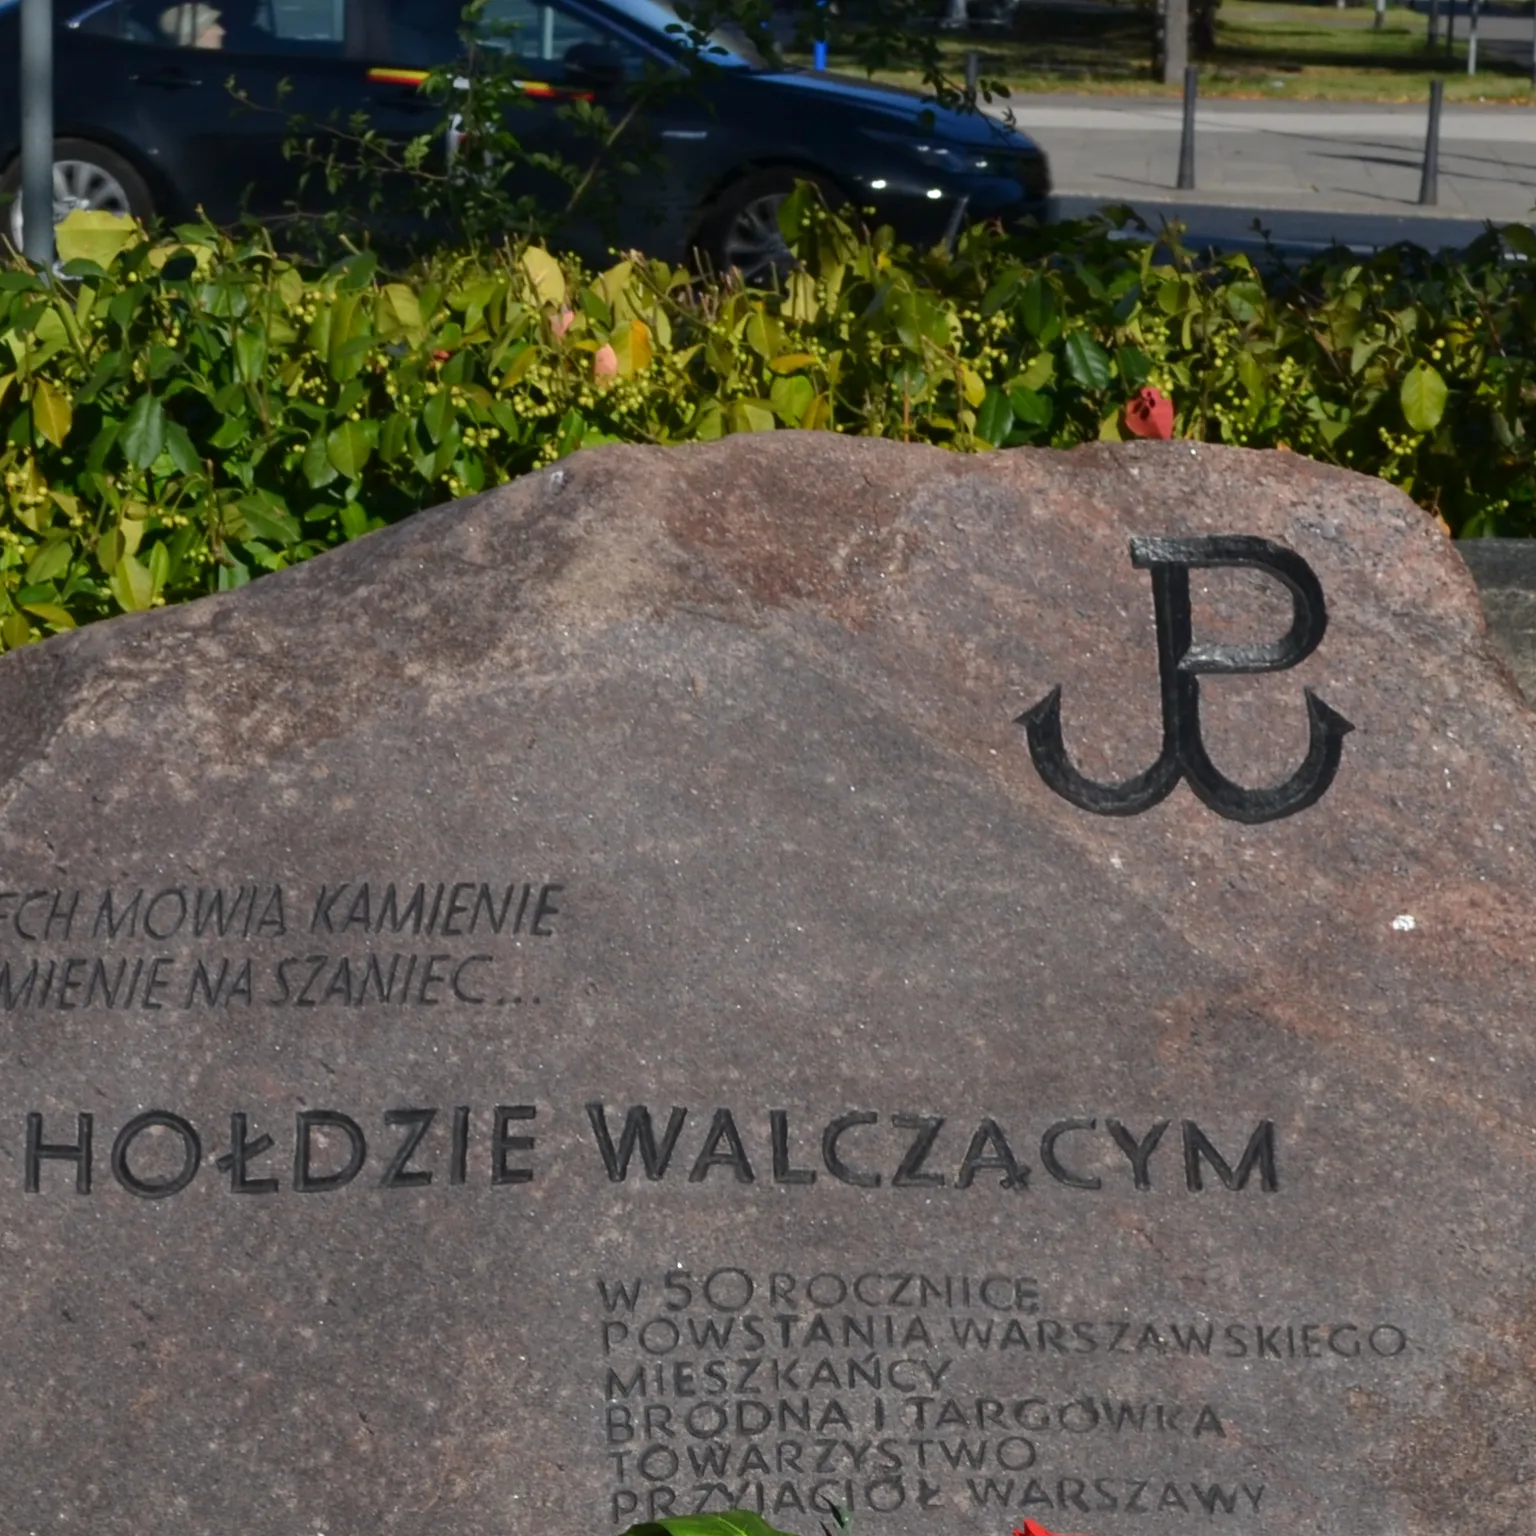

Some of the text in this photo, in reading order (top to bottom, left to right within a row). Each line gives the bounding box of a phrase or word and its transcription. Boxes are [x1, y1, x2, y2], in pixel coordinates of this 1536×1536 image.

[310, 881, 565, 938] KAMIENIE
[183, 956, 253, 1011] NA
[23, 1104, 538, 1200] HOŁDZIE
[584, 1101, 1280, 1193] WALCZĄCYM
[595, 1265, 1041, 1316] W 50 ROCZNICĘ
[601, 1313, 1408, 1359] POWSTANIA WARSZAWSKIEGO
[603, 1350, 954, 1400] MIESZKAŃCY
[874, 1396, 887, 1432] I
[903, 1395, 1227, 1439] TARGÓWKA
[608, 1435, 1037, 1484] TOWARZYSTWO
[966, 1476, 1266, 1519] WARSZAWY
